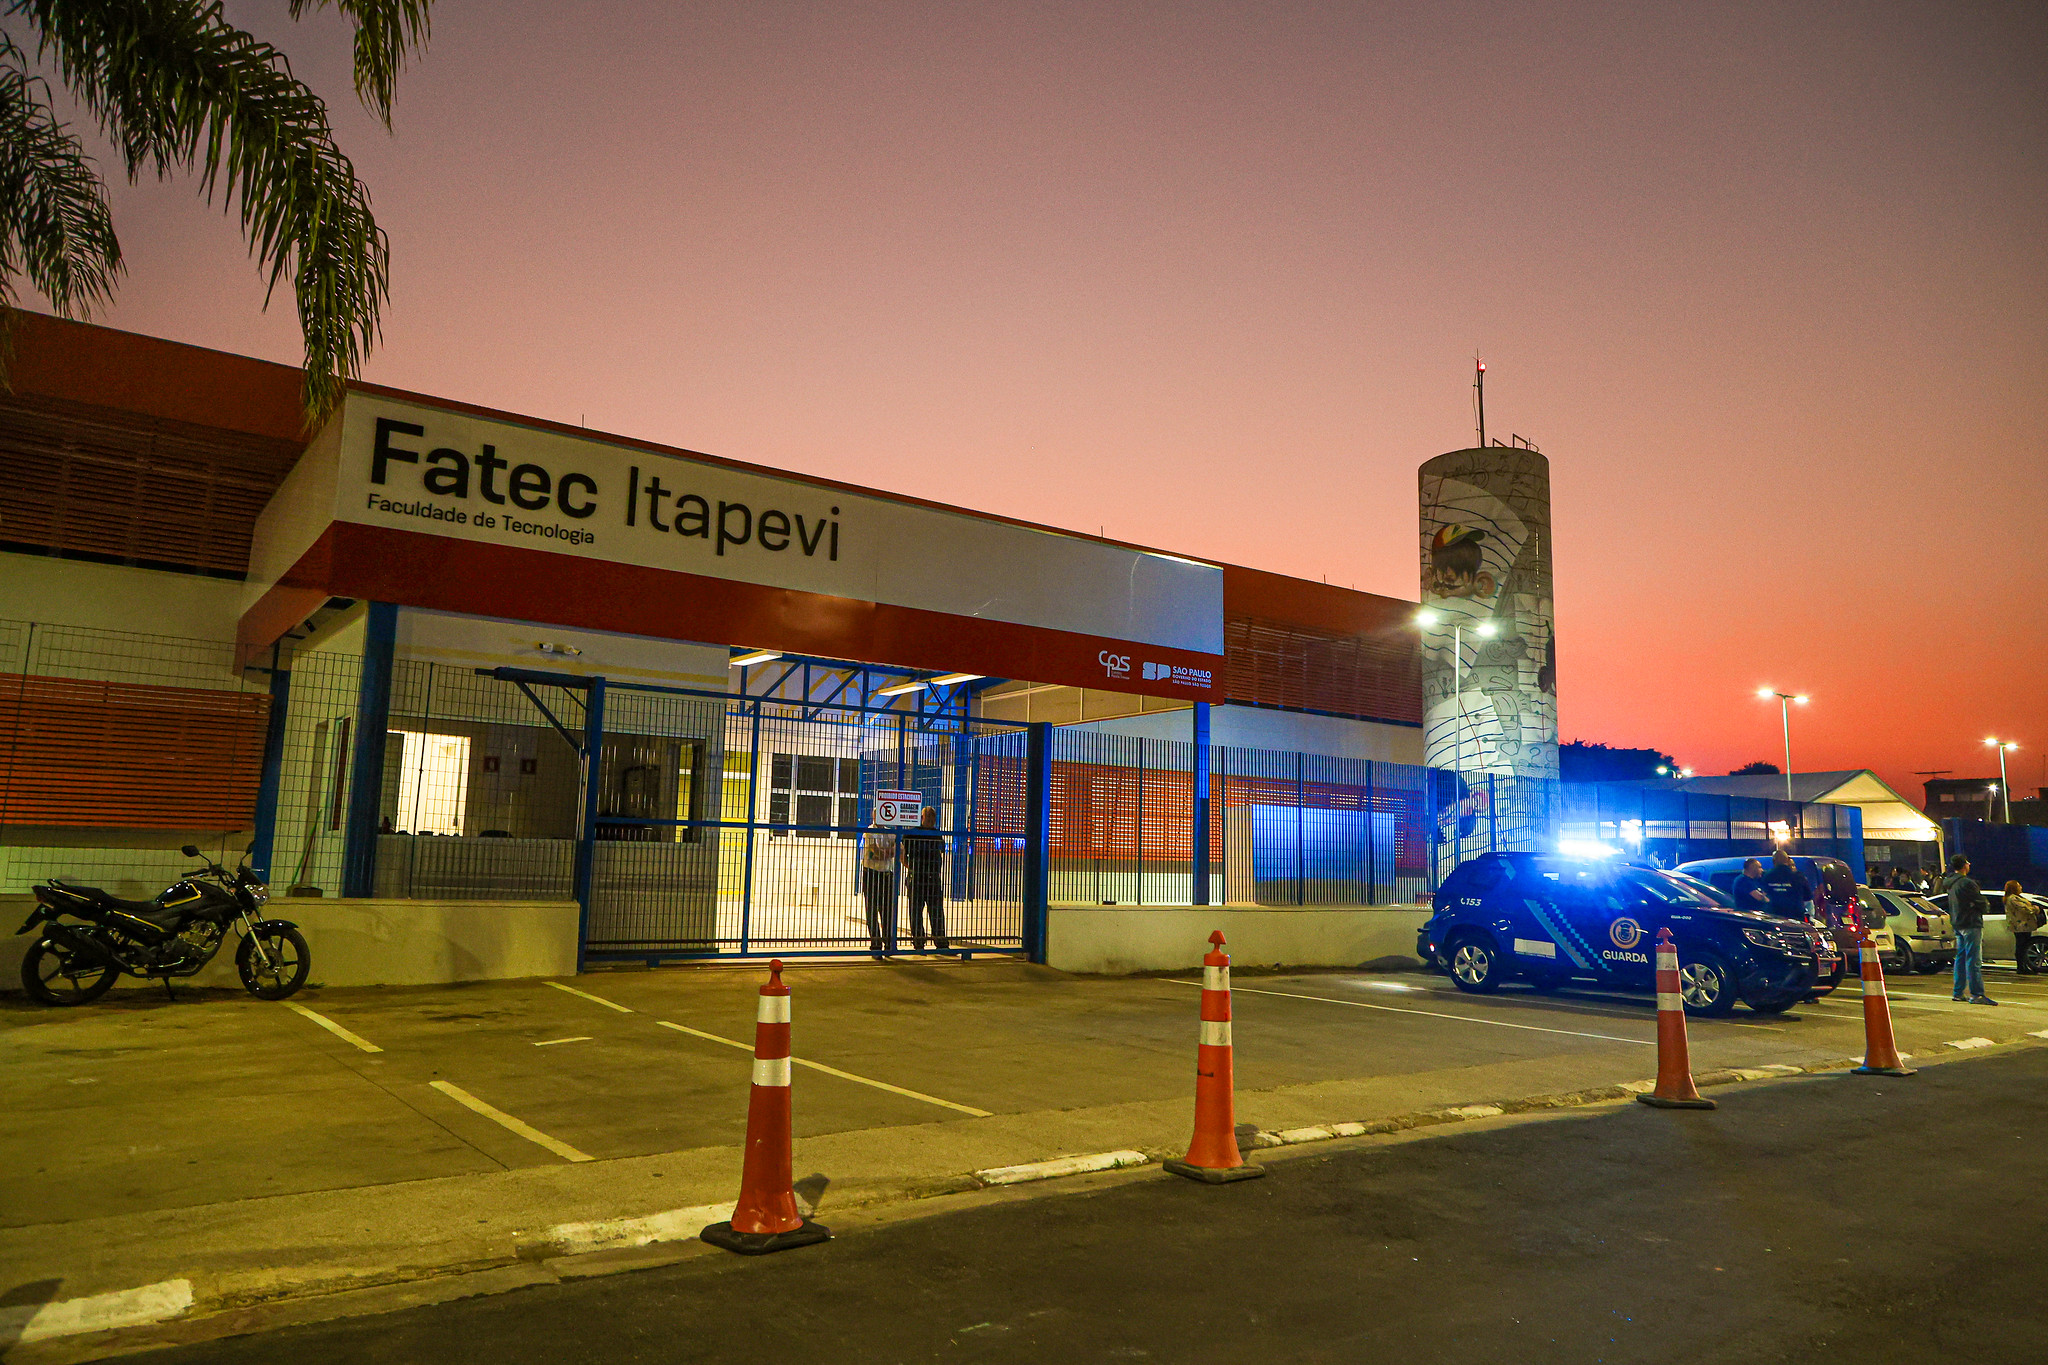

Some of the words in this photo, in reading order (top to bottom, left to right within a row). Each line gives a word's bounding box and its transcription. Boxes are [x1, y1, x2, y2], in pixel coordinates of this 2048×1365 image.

[371, 417, 598, 519] Fatec
[626, 465, 840, 561] Itapevi
[367, 493, 467, 524] Faculdade
[473, 511, 496, 529] de
[502, 515, 595, 545] Tecnologia
[1188, 668, 1212, 679] PAULO
[879, 792, 897, 800] PROIBIDO
[898, 793, 920, 801] ESTACIONAR
[1466, 898, 1482, 907] 153
[1603, 950, 1649, 964] GUARDA
